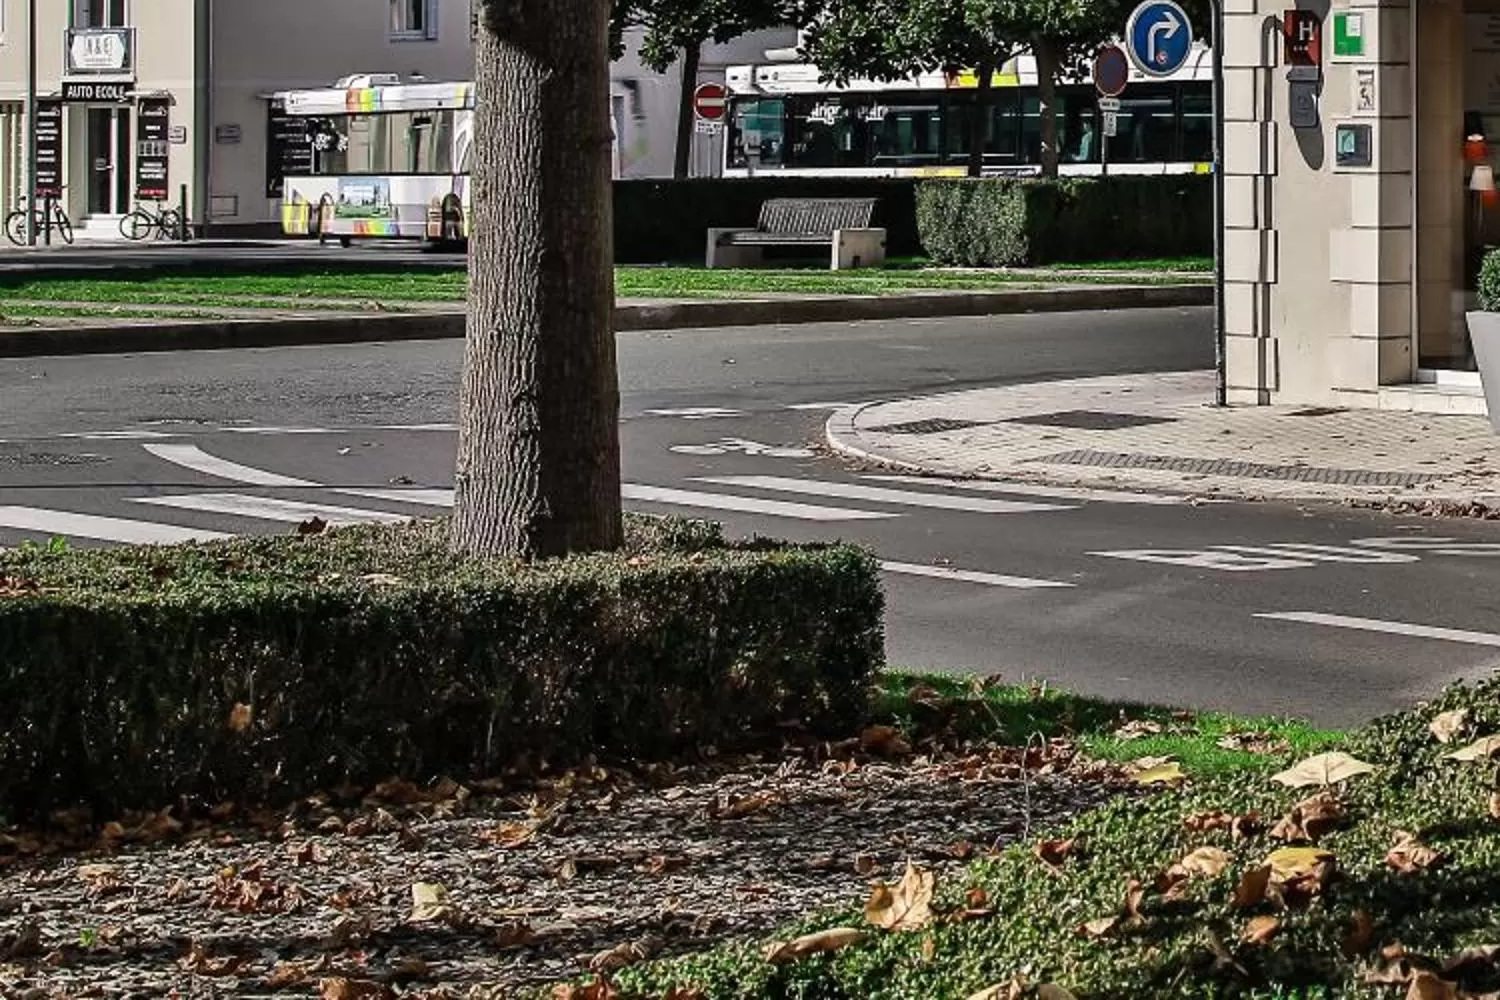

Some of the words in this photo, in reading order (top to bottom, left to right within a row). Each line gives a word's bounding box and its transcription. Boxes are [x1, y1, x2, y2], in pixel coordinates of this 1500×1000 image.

[1299, 21, 1314, 41] H
[67, 85, 93, 99] AUTO
[95, 85, 126, 100] ECOLE
